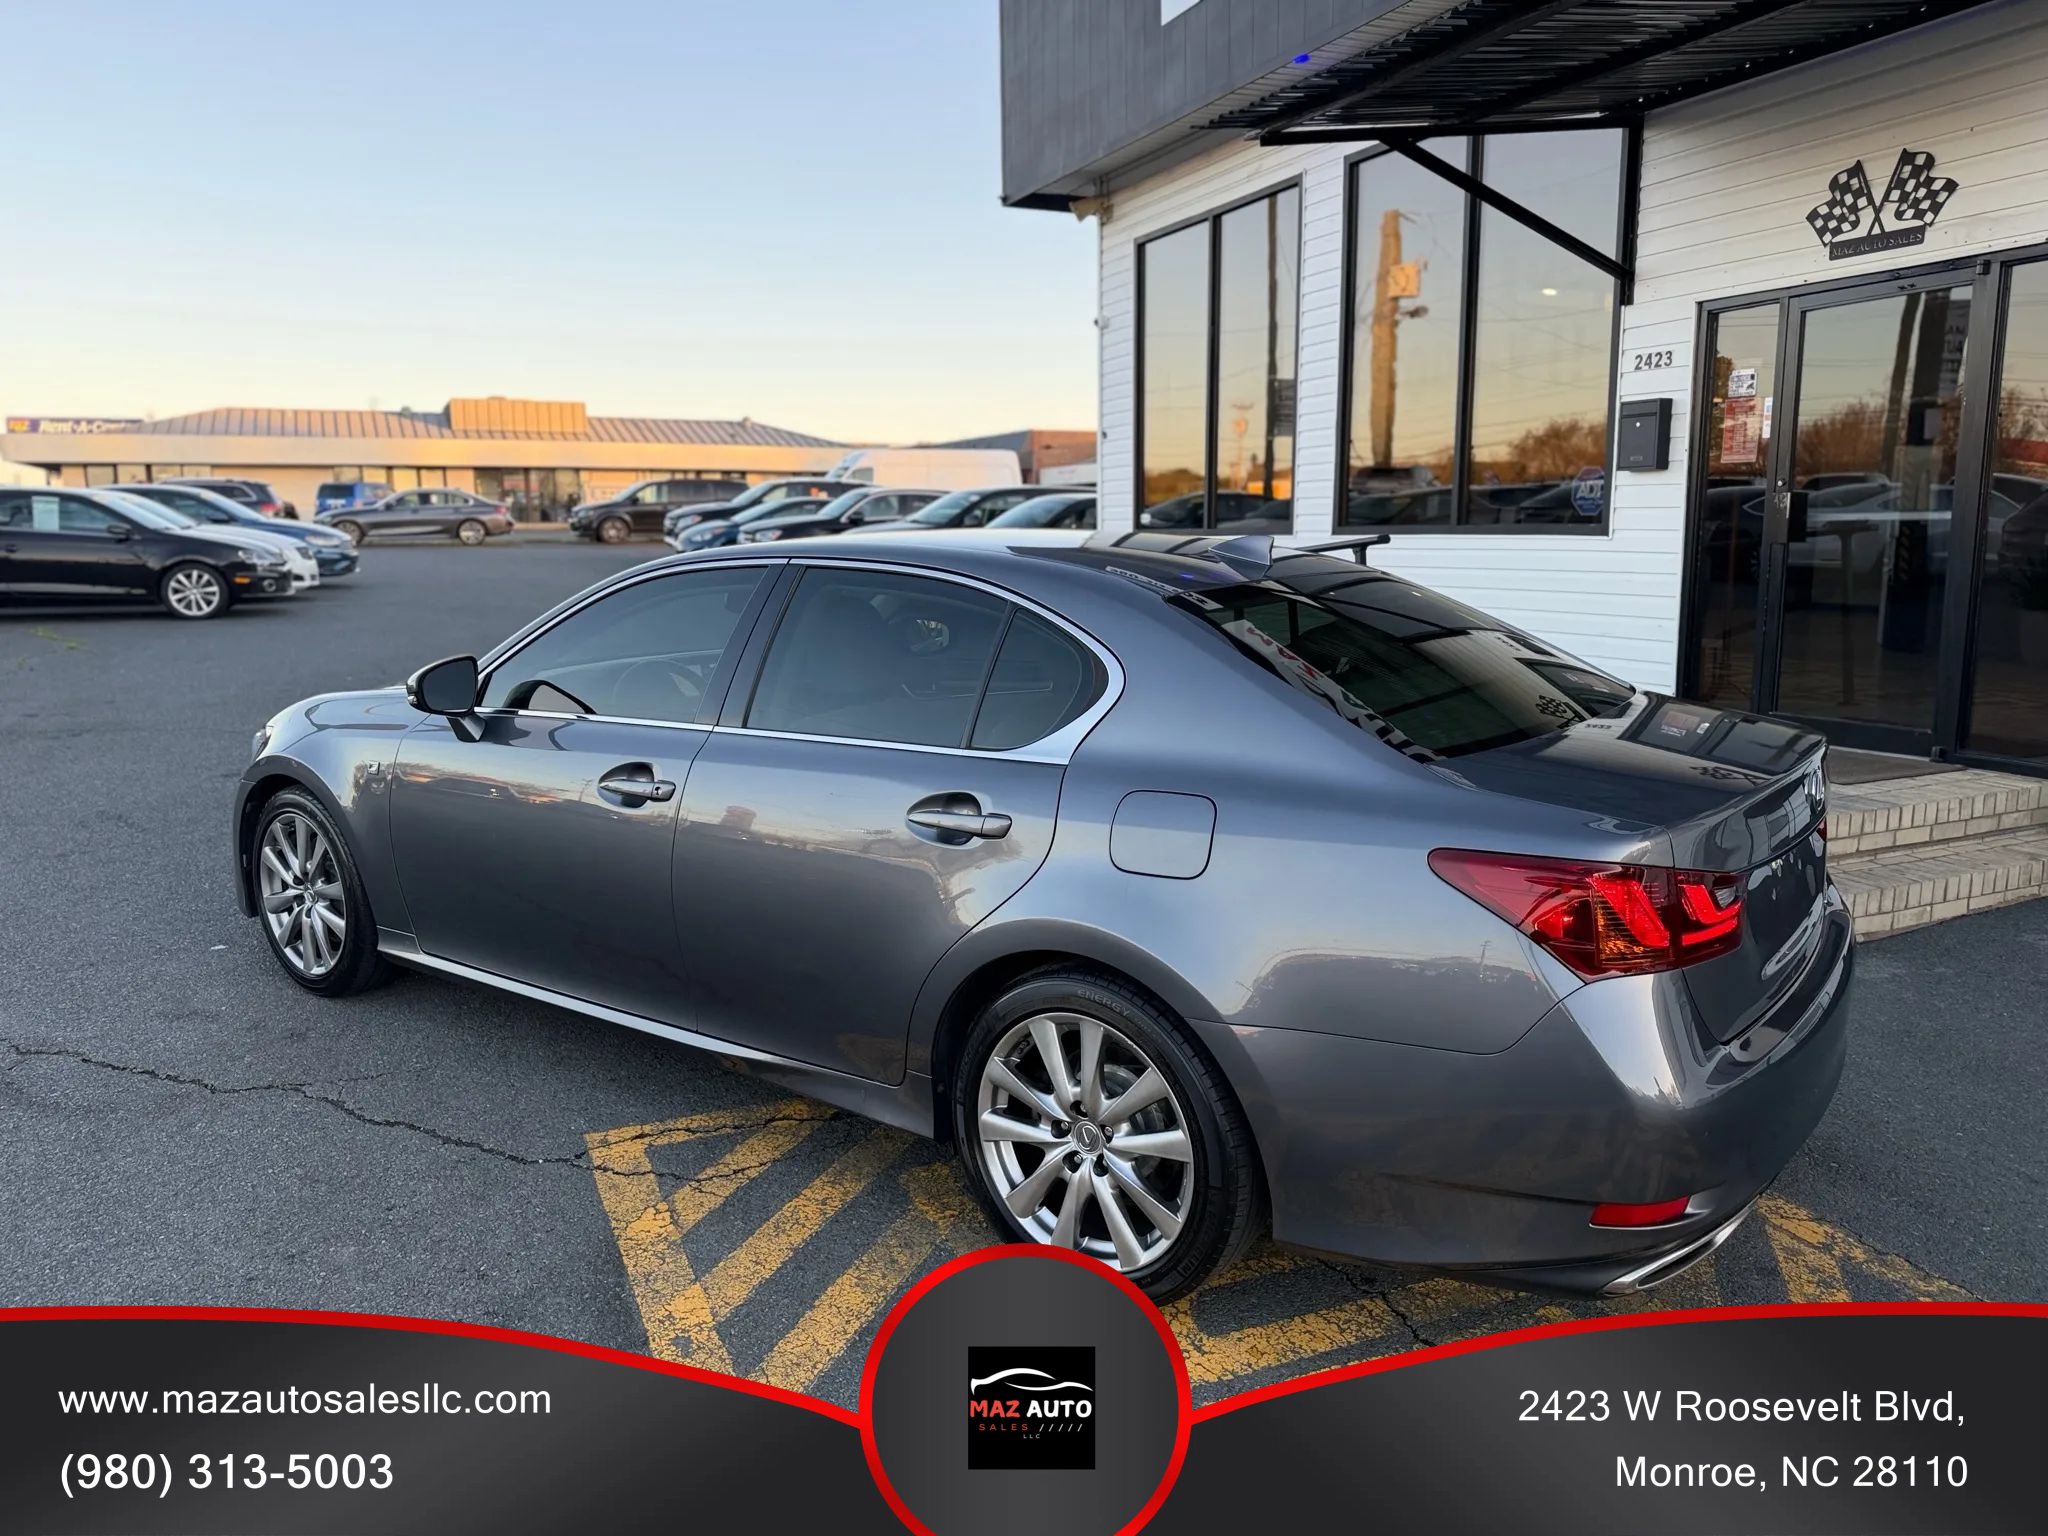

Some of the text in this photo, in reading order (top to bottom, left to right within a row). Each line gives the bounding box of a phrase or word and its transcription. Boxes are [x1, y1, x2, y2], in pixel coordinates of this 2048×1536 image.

[1857, 238, 1887, 252] AUTO
[1888, 233, 1922, 247] SALES
[1634, 351, 1673, 370] 2423
